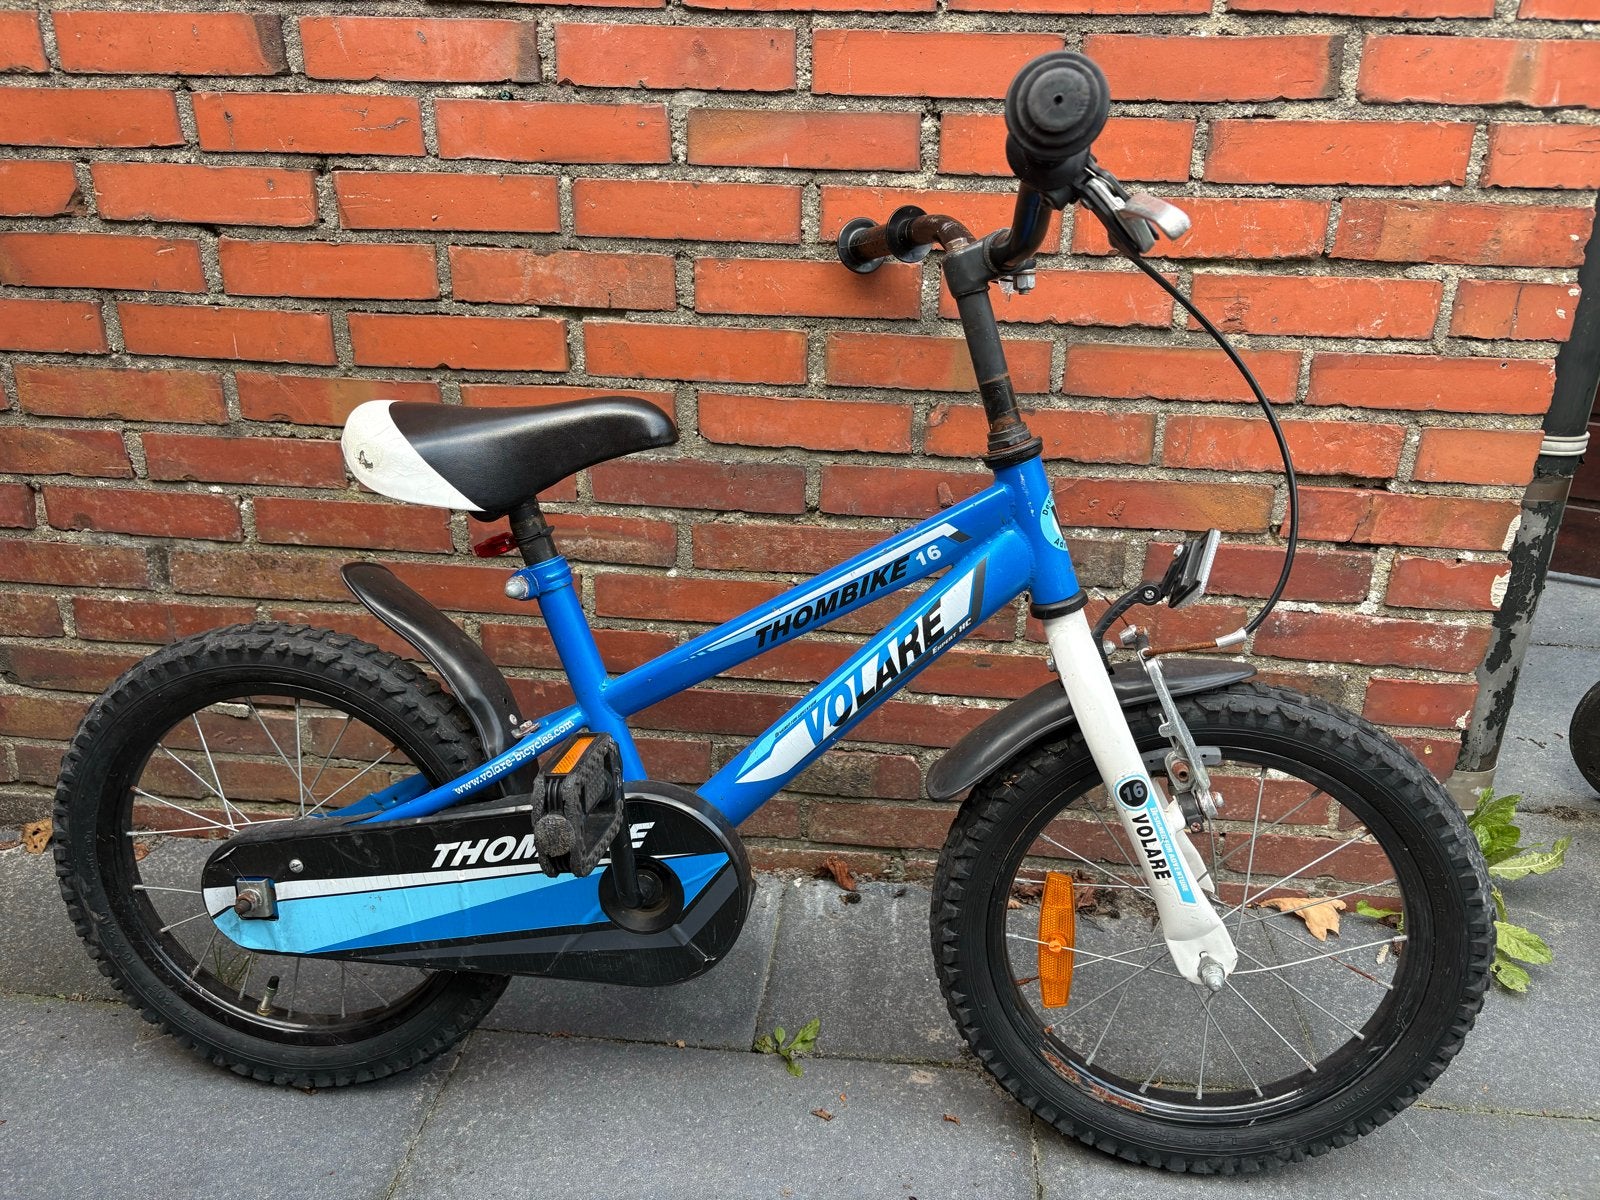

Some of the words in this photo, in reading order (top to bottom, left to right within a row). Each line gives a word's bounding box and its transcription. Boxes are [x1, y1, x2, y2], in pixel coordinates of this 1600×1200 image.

[755, 554, 911, 649] THOMBIKE
[915, 544, 942, 567] 16
[803, 596, 946, 747] VOLARE
[453, 718, 574, 796] www.volare-bicycles.com
[1122, 782, 1144, 802] 16
[431, 821, 655, 868] THOME
[1131, 813, 1172, 880] VOLARE
